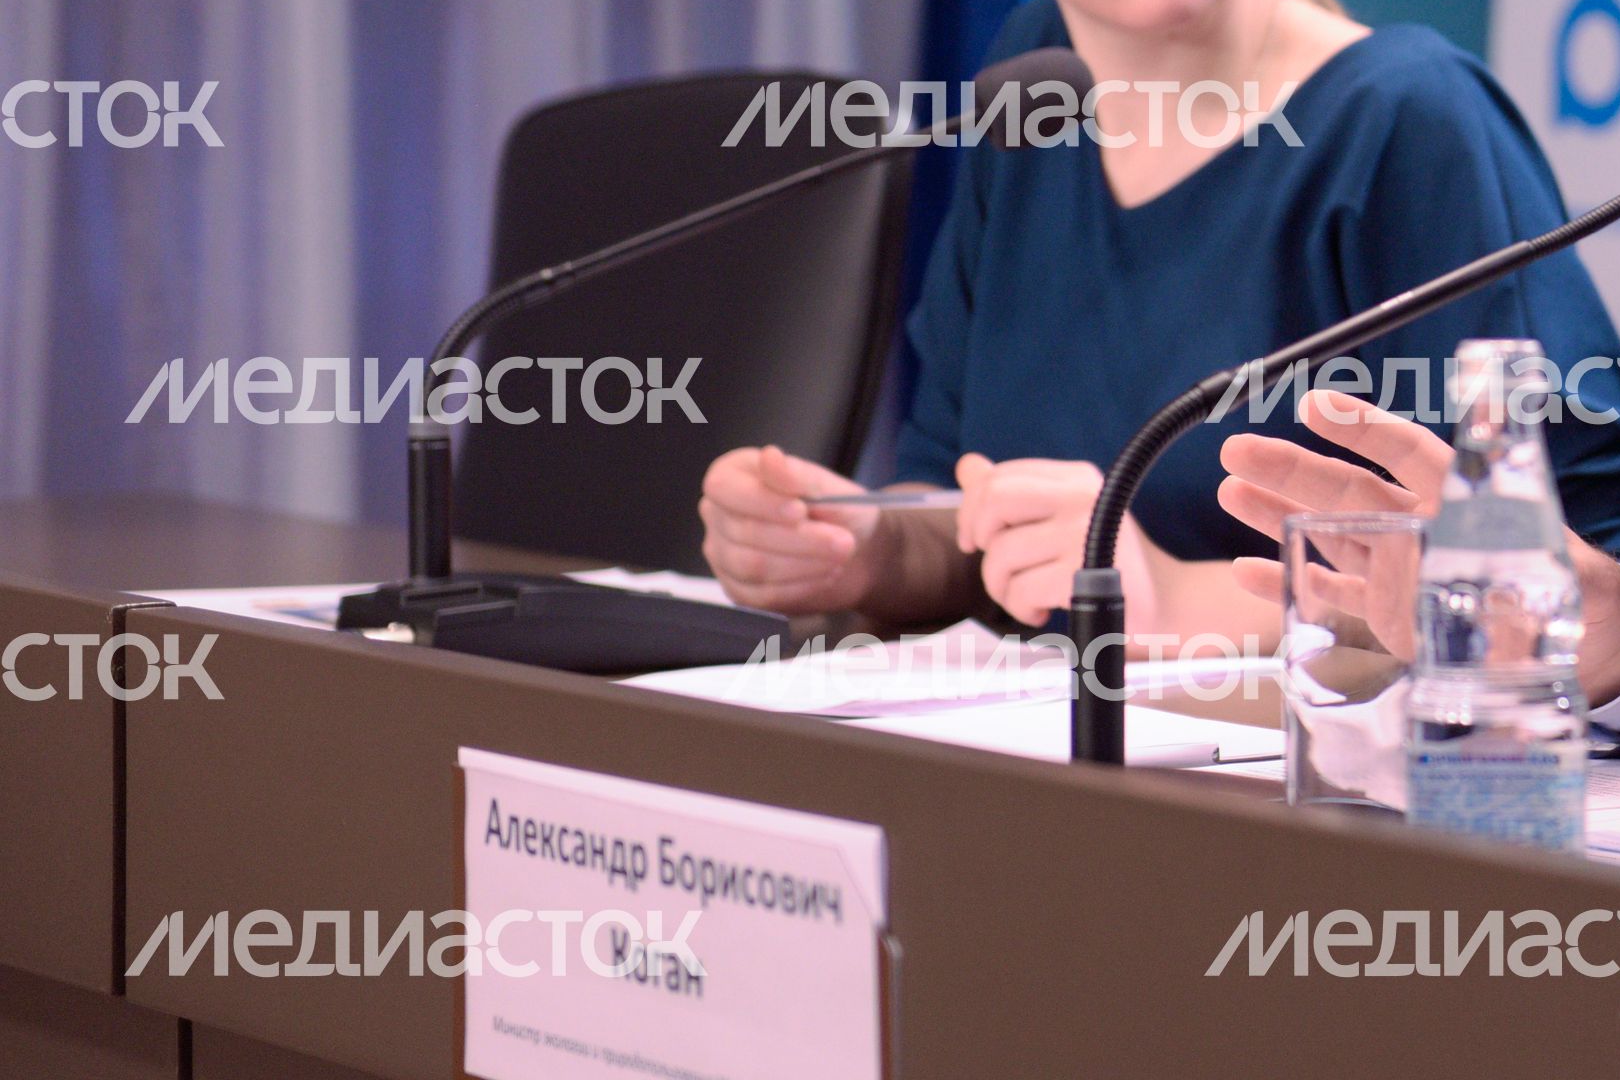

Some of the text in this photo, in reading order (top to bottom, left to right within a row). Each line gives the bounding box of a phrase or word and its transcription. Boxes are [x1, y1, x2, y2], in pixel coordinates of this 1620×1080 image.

[485, 798, 843, 923] Александр Борисович
[611, 927, 704, 997] Коган
